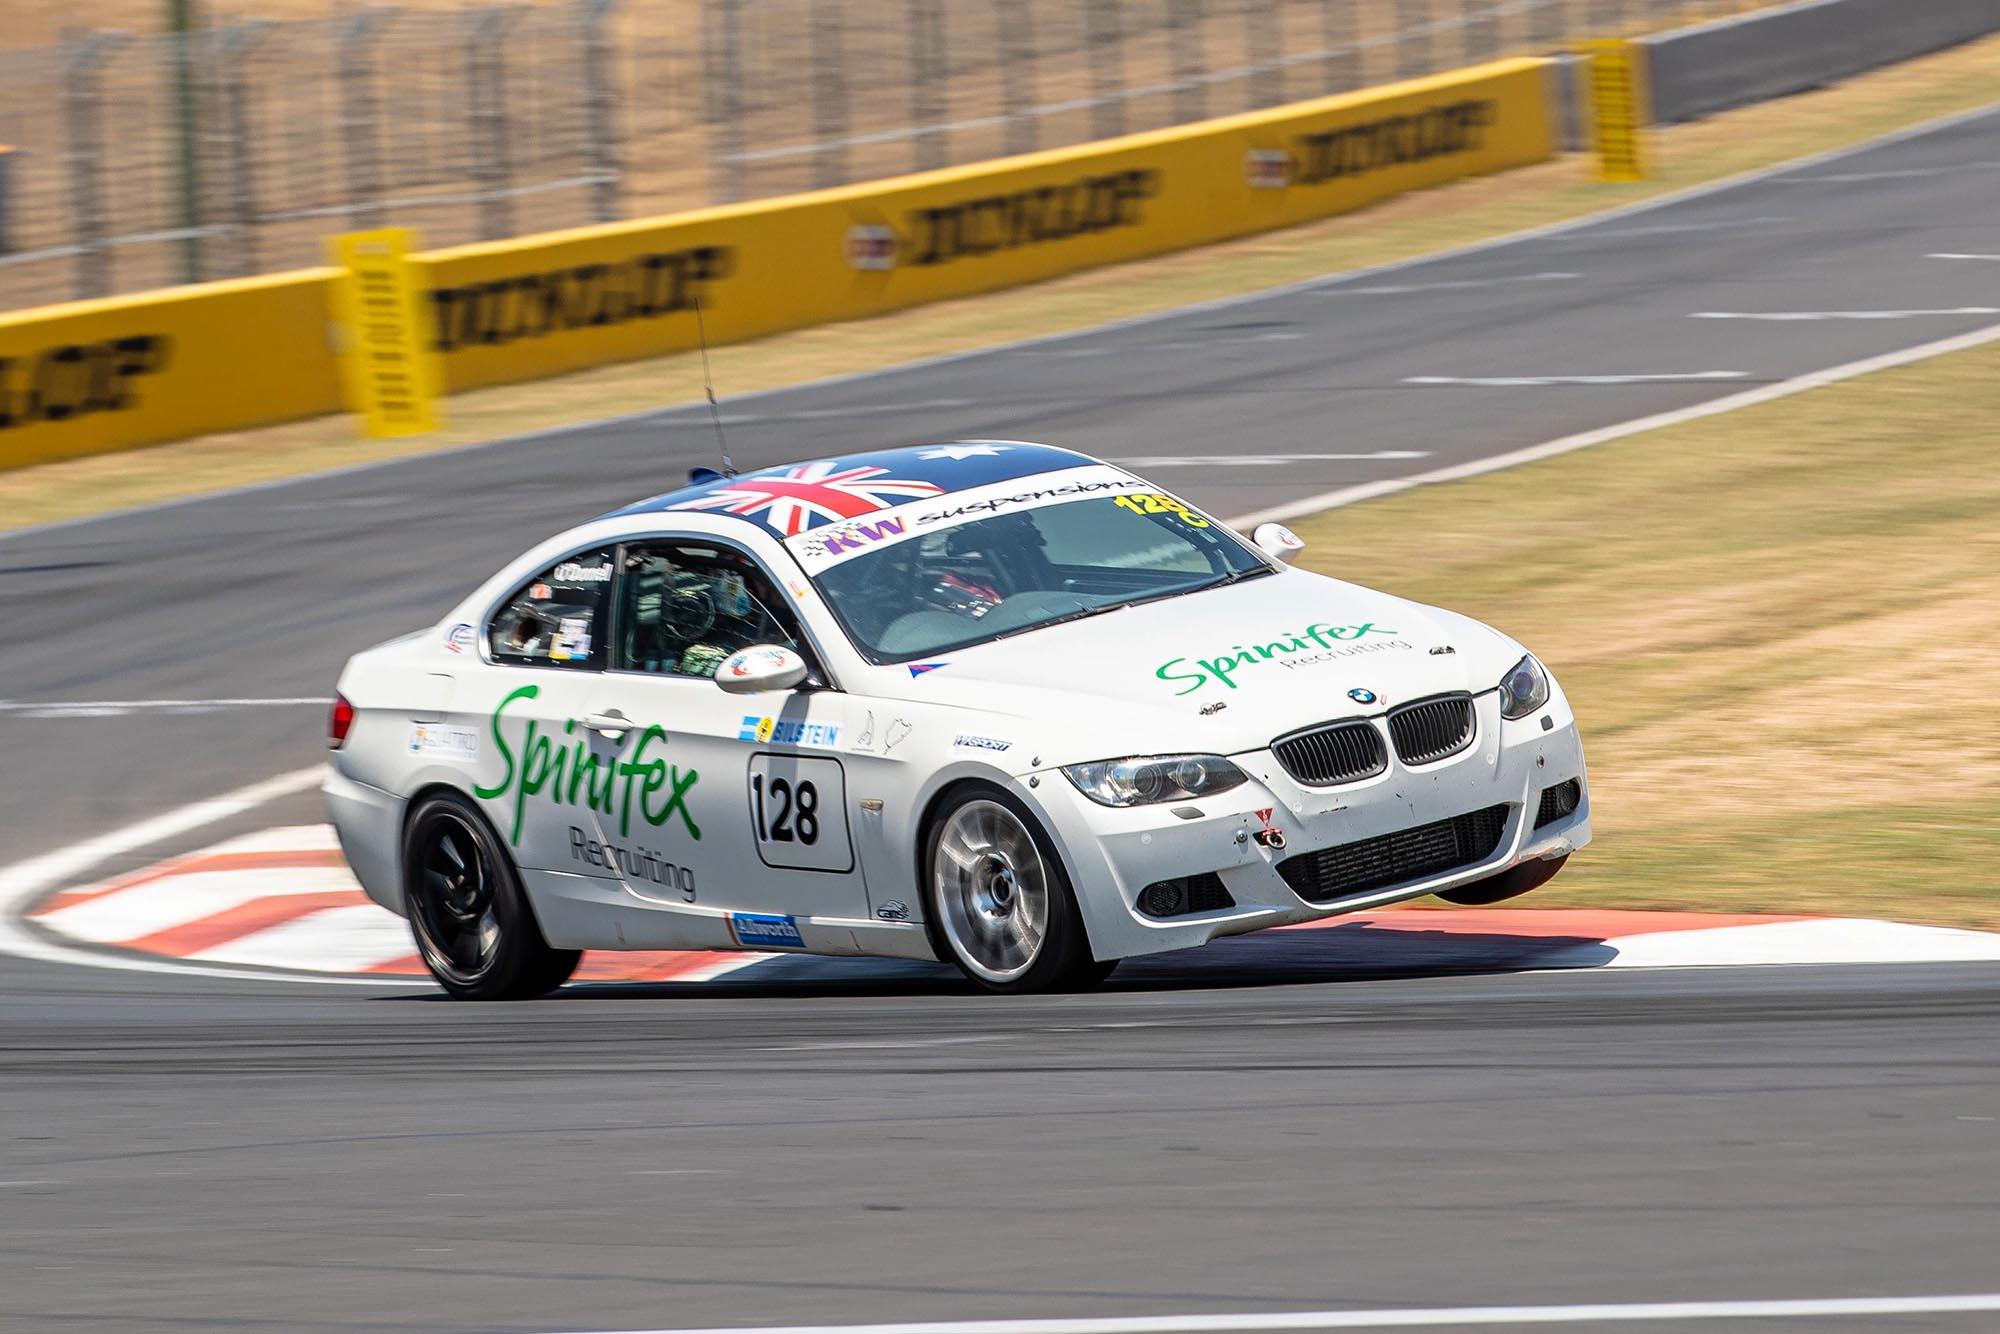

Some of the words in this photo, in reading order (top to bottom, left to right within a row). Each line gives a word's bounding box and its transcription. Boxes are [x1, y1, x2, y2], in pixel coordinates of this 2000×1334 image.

[821, 515, 908, 556] KW
[916, 480, 1147, 526] suspensions
[1113, 493, 1190, 516] 128
[1156, 623, 1399, 696] Spinifex
[1280, 639, 1413, 670] Recruiting
[472, 685, 701, 848] Spinifex
[771, 721, 839, 746] BILSTEIN
[752, 773, 819, 846] 128
[568, 825, 697, 903] Recruiting
